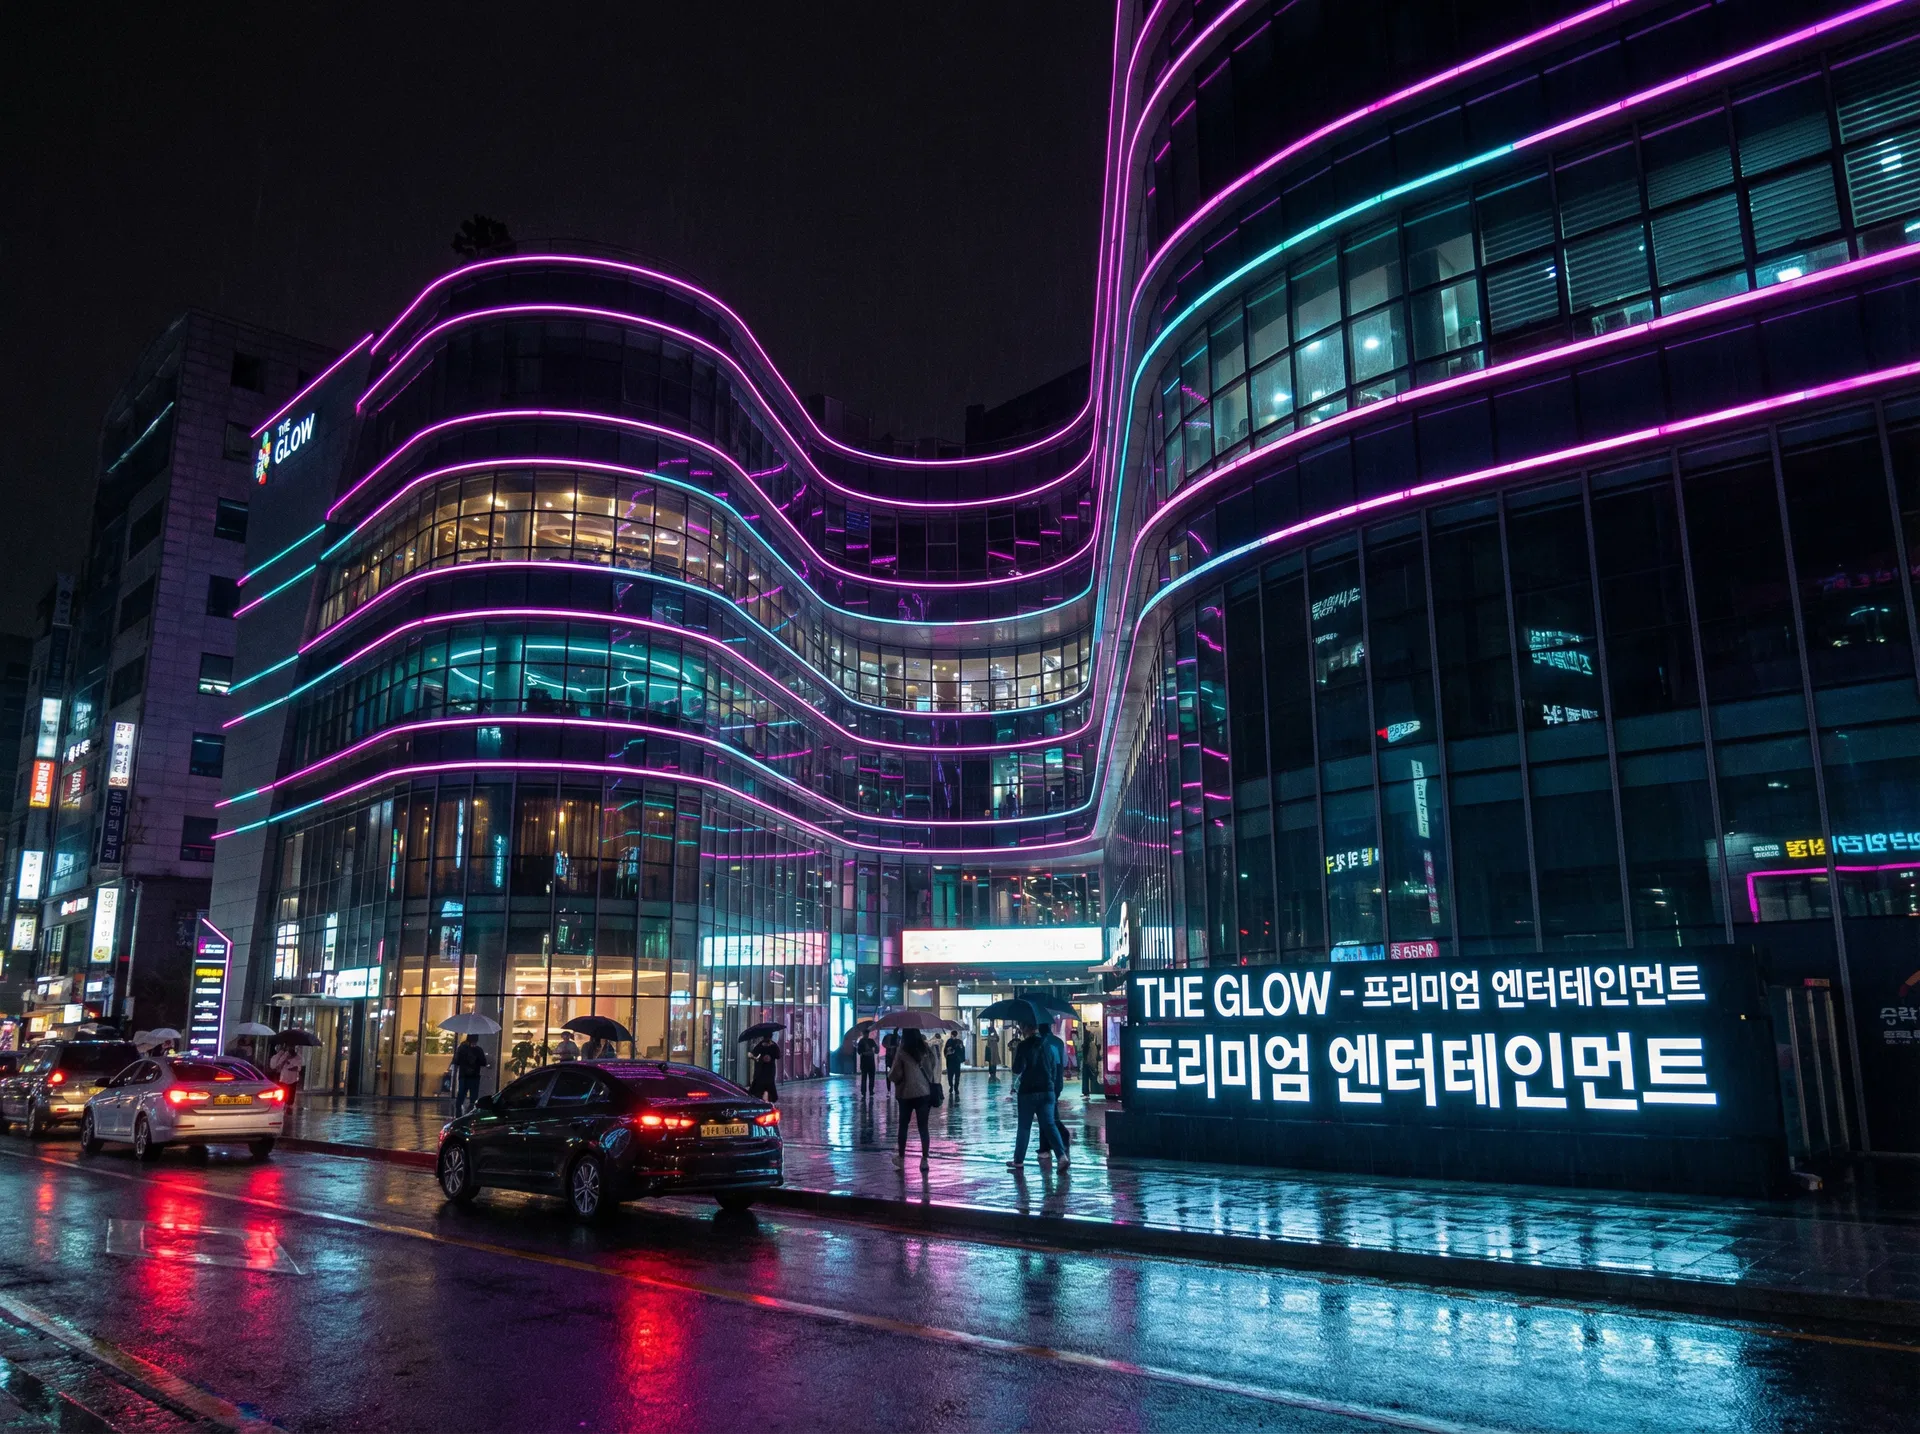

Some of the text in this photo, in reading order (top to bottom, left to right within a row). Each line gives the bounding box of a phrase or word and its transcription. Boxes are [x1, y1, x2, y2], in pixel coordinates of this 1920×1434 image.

[275, 412, 315, 465] GLOW
[1136, 975, 1205, 1017] THE
[1214, 971, 1331, 1017] GLOW
[1363, 970, 1480, 1011] 프리미엄
[1491, 964, 1706, 1008] 엔터테인먼트
[1137, 1032, 1718, 1110] 프리미엄 엔터테인먼트
